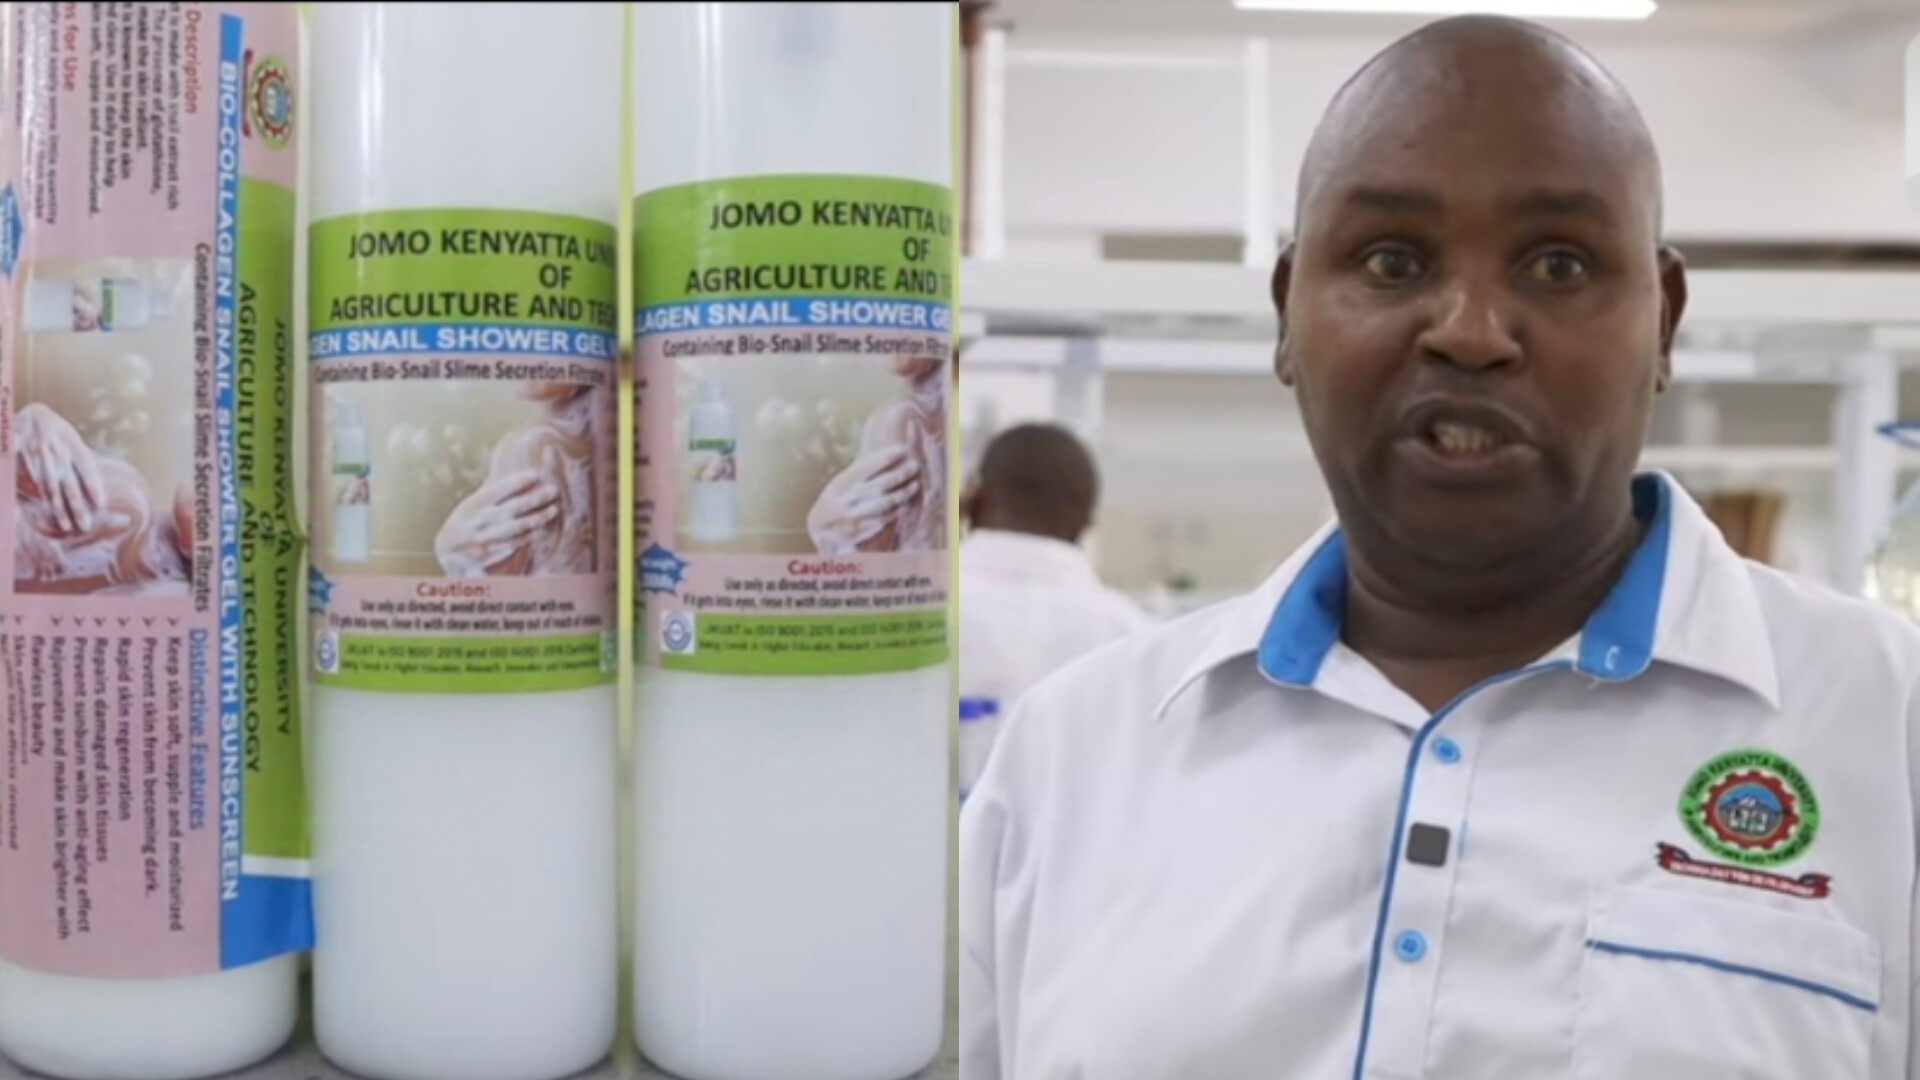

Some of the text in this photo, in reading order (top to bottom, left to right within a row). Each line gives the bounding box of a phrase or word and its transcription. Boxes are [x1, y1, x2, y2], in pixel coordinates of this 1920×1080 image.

[63, 25, 78, 50] for
[63, 57, 78, 92] Use
[183, 9, 202, 114] Description
[710, 200, 803, 230] JOMO
[812, 200, 936, 233] KENYATTA
[348, 229, 431, 259] JOMO
[440, 229, 580, 261] KENYATTA
[902, 236, 930, 263] OF
[539, 263, 573, 289] OF
[684, 265, 887, 294] AGRICULTURE
[894, 267, 937, 295] AND
[330, 293, 519, 321] AGRICULTURE
[528, 295, 583, 320] AND
[707, 301, 800, 325] SNAIL
[808, 300, 927, 326] SHOWER
[346, 328, 428, 352] SNAIL
[436, 327, 570, 352] SHOWER
[663, 336, 734, 358] Containing
[738, 334, 813, 354] Bio-Snail
[816, 334, 862, 353] Slime
[866, 335, 926, 355] Secretion
[371, 359, 441, 381] Bio-Snail
[445, 359, 490, 380] Slime
[495, 360, 566, 381] Secretion
[193, 242, 213, 612] Containing Bio-Snail Slime Secretion Filtrates
[216, 61, 240, 900] BIO-COLLAGEN SNAIL SHOWER GEL WITH SUNSCREEN
[238, 282, 259, 773] AGRICULTURE AND TECHNOLOGY
[274, 318, 294, 735] JOMO KENYATTA UNIVERSITY
[788, 560, 863, 576] Caution:
[416, 582, 491, 598] Caution:
[74, 636, 90, 697] Prevent
[92, 637, 109, 695] Repairs
[142, 637, 158, 697] Prevent
[164, 637, 182, 676] Keep
[48, 636, 66, 723] Rejuvenate
[167, 679, 183, 710] skin
[74, 701, 90, 765] sunburn
[91, 699, 110, 771] damaged
[115, 637, 133, 821] Rapid skin regeneration
[143, 702, 158, 733] skin
[189, 628, 209, 830] Distinctive Features
[52, 727, 67, 757] and
[143, 737, 158, 774] from
[53, 761, 68, 802] make
[75, 769, 90, 805] with
[95, 775, 110, 805] skin
[165, 754, 183, 804] supple
[54, 806, 68, 837] skin
[141, 778, 158, 854] becoming
[168, 809, 183, 838] and
